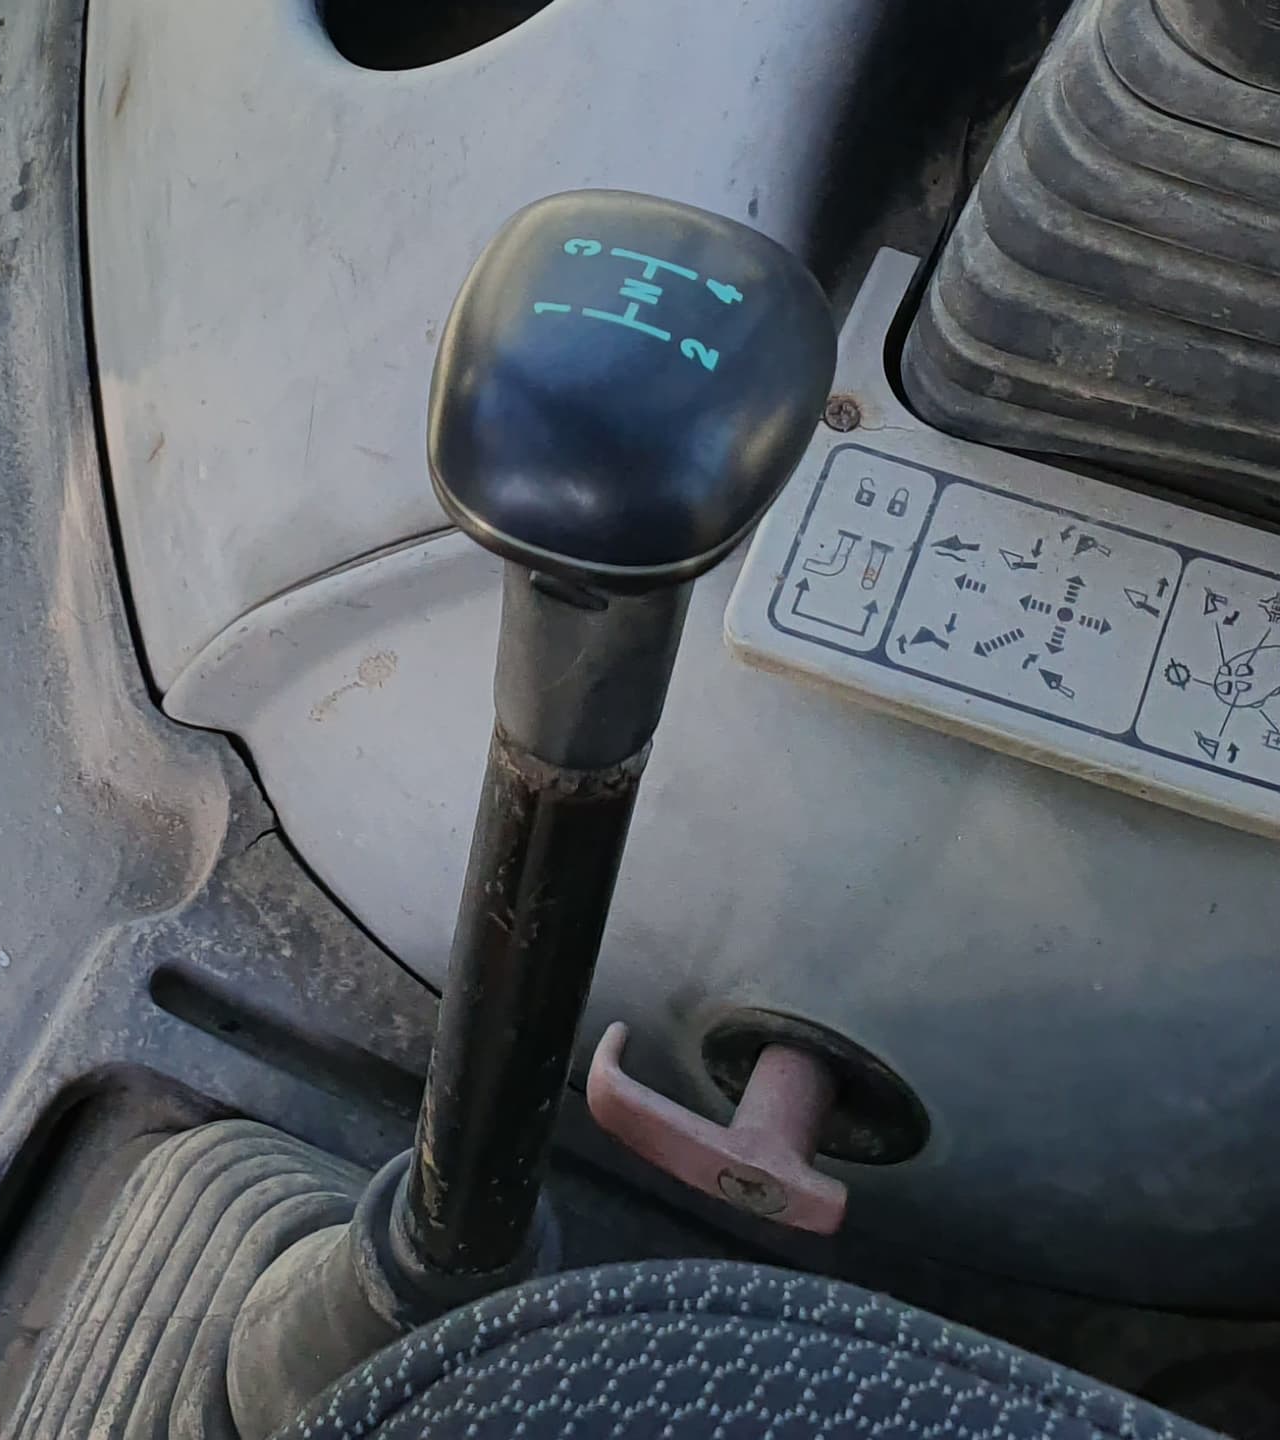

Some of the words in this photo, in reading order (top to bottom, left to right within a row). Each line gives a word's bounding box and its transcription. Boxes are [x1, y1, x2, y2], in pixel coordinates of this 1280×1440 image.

[564, 238, 602, 257] 3
[706, 279, 743, 304] 4
[534, 302, 571, 314] 1
[680, 338, 719, 372] 2
